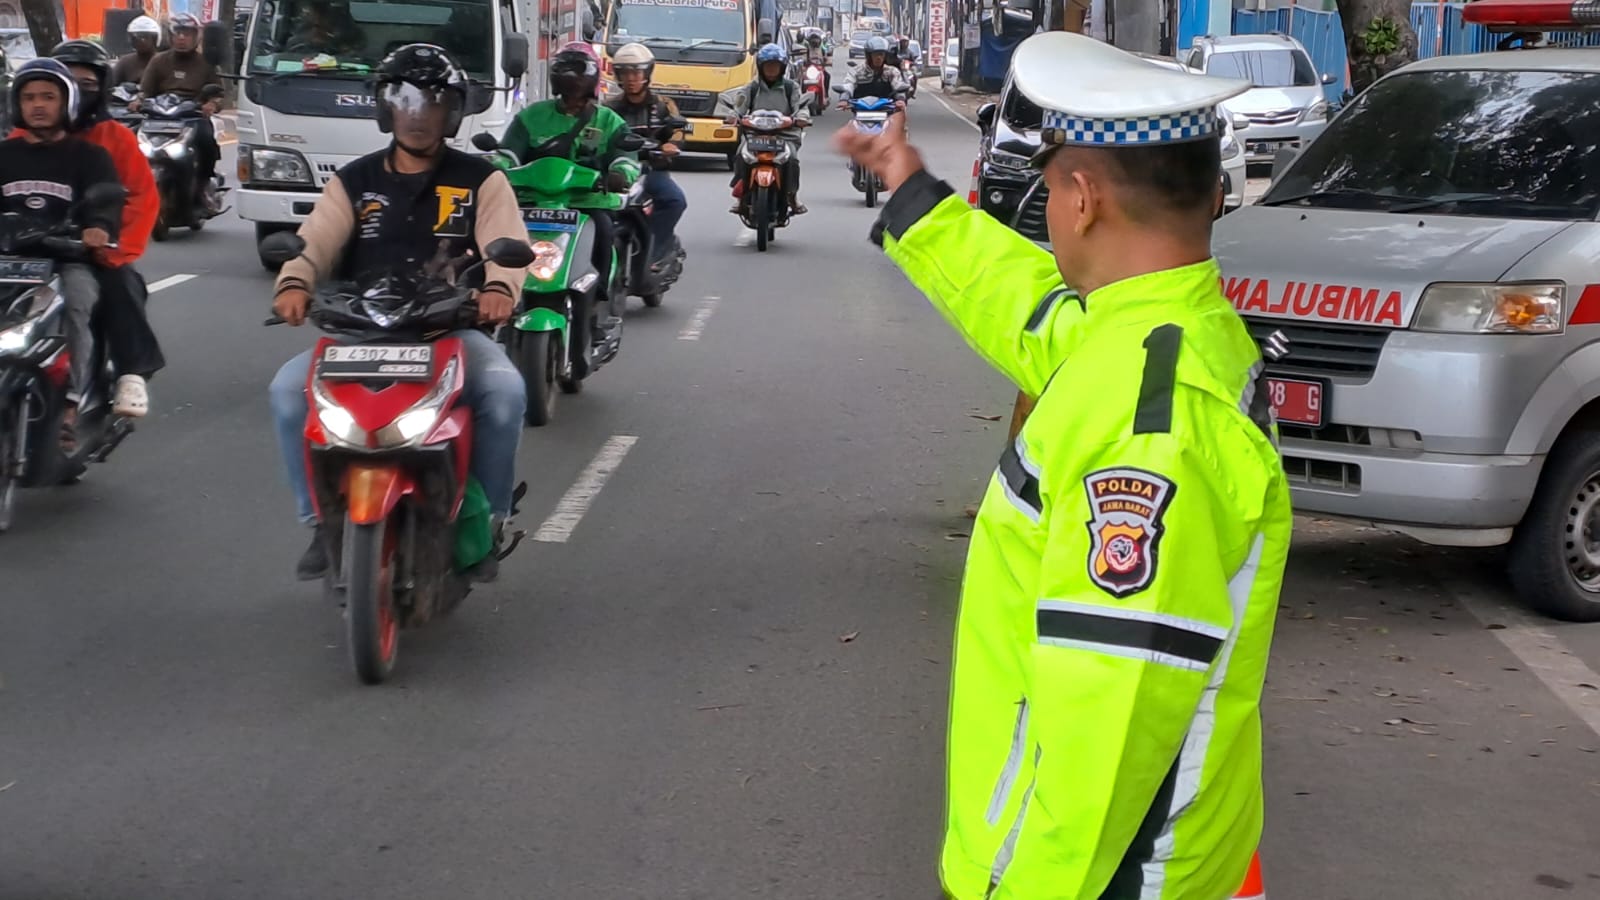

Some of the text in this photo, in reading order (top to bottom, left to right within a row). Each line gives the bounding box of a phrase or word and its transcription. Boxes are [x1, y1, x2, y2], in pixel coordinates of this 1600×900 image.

[704, 0, 736, 8] Putra
[931, 3, 943, 45] KITCHEN
[329, 348, 338, 360] B
[1308, 385, 1319, 410] G
[1097, 480, 1153, 497] POLDA
[1103, 501, 1151, 517] JAWA BARAT
